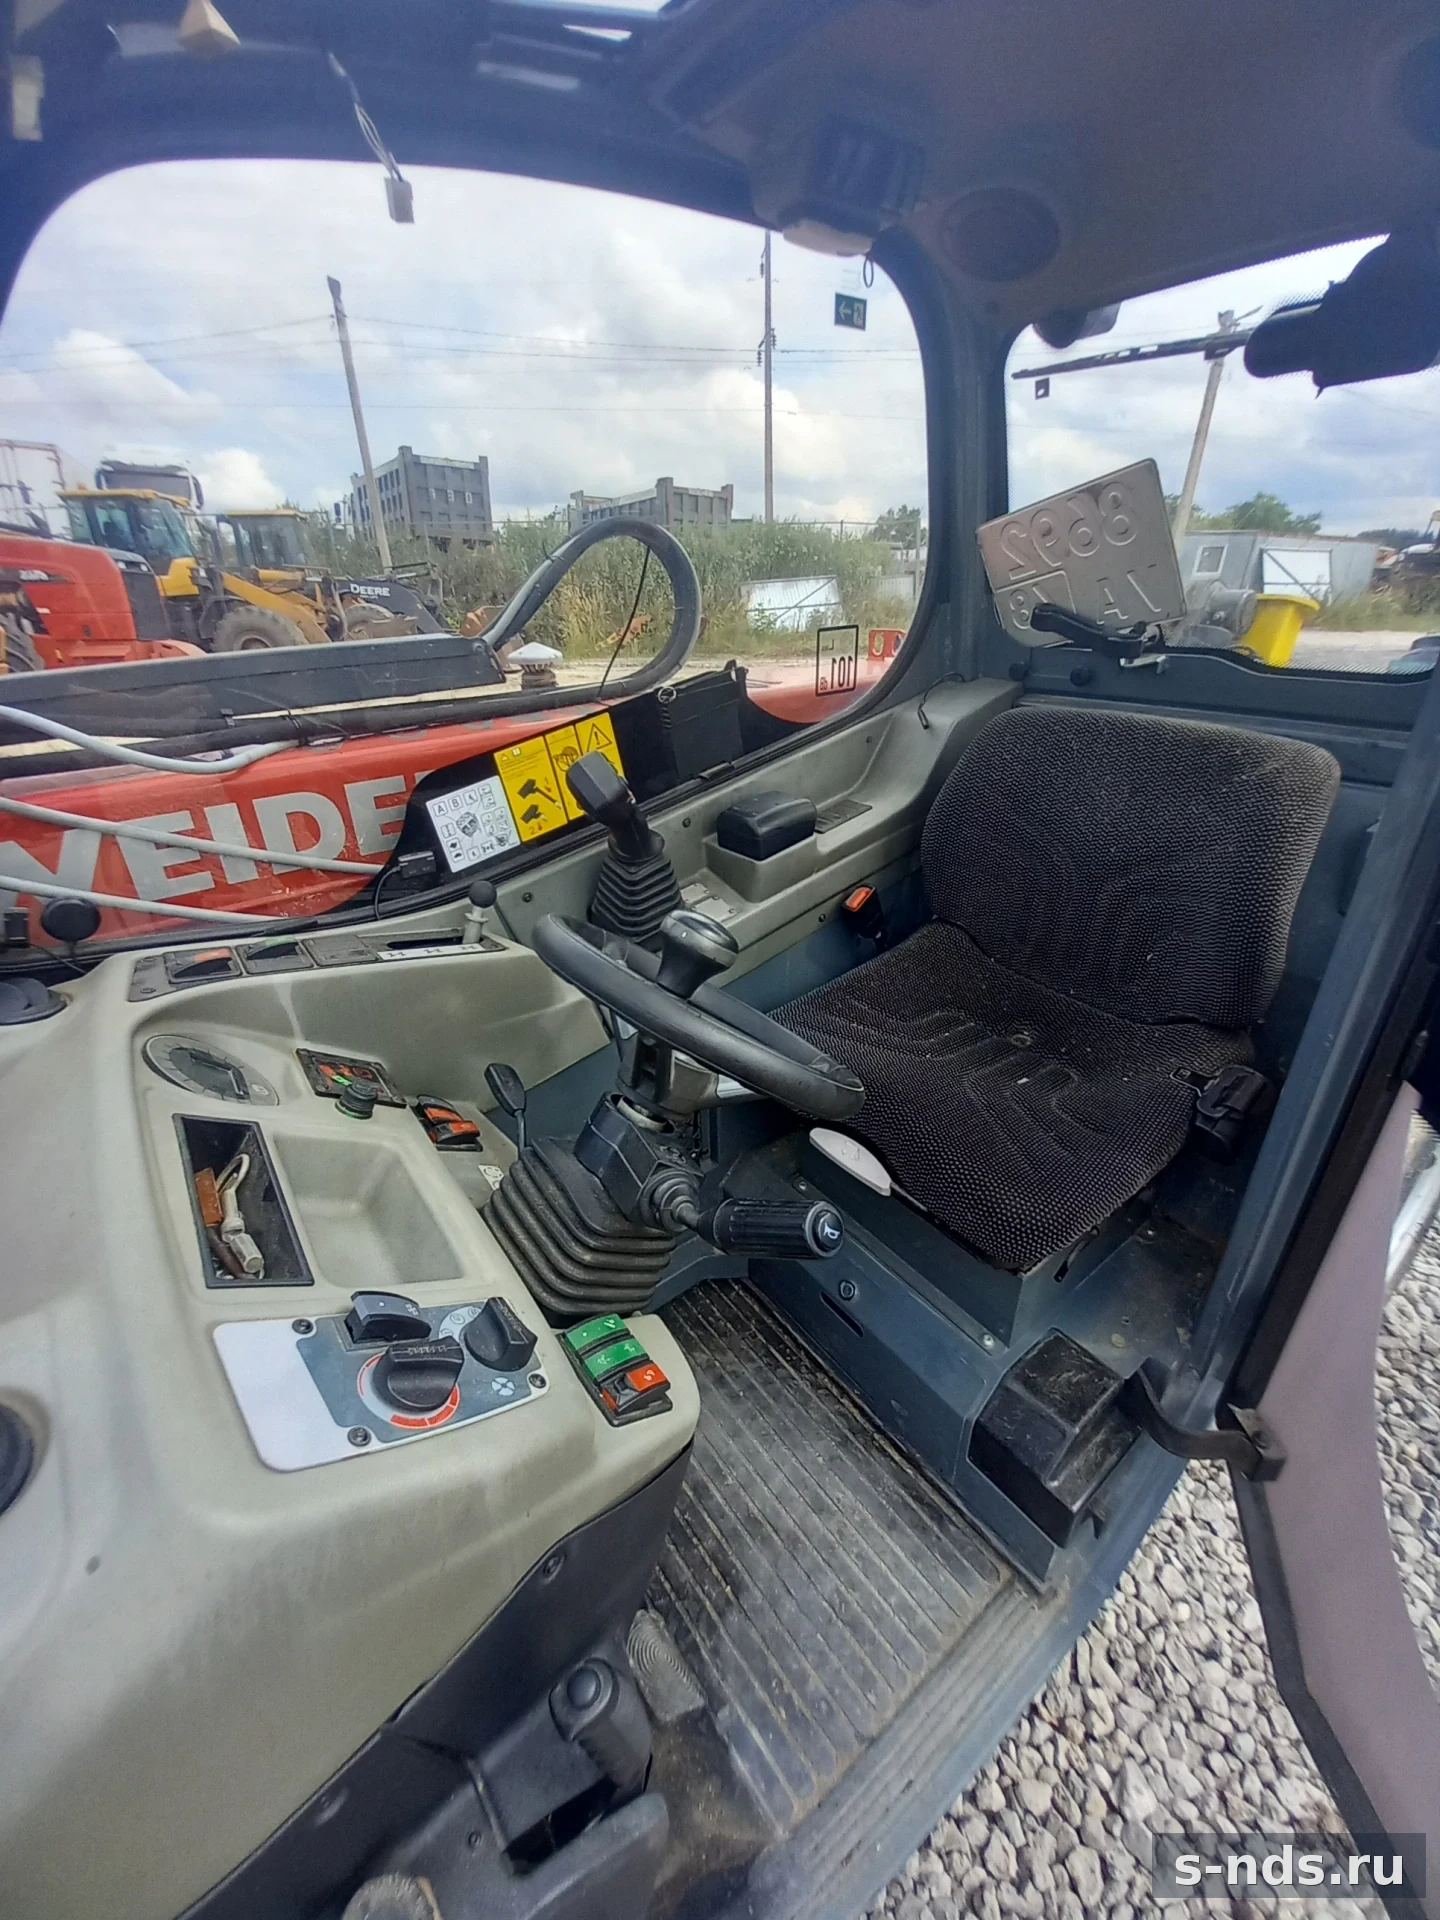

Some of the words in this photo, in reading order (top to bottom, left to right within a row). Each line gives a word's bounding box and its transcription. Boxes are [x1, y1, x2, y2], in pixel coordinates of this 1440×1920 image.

[350, 583, 391, 597] DEERE
[451, 798, 460, 808] B
[437, 804, 445, 814] A
